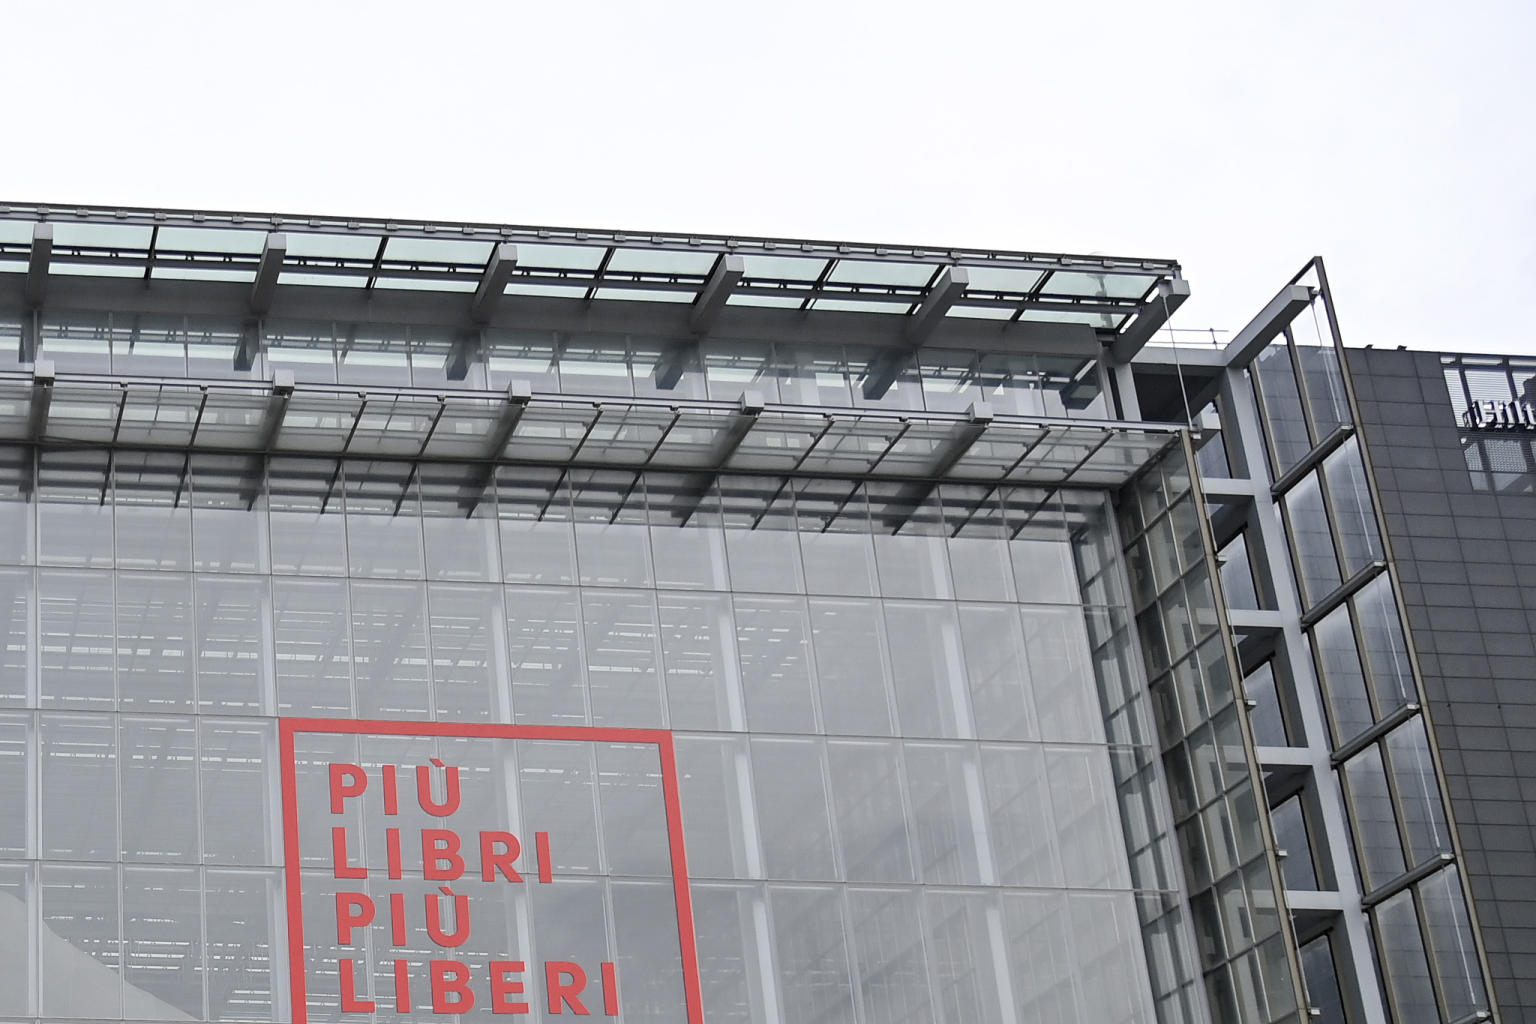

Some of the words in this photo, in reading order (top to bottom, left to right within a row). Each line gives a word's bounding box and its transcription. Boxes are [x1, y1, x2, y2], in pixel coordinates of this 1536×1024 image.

[329, 758, 462, 817] PIÙ
[332, 826, 553, 884] LIBRI
[335, 886, 471, 948] PIÙ
[339, 958, 620, 1016] LIBERI
